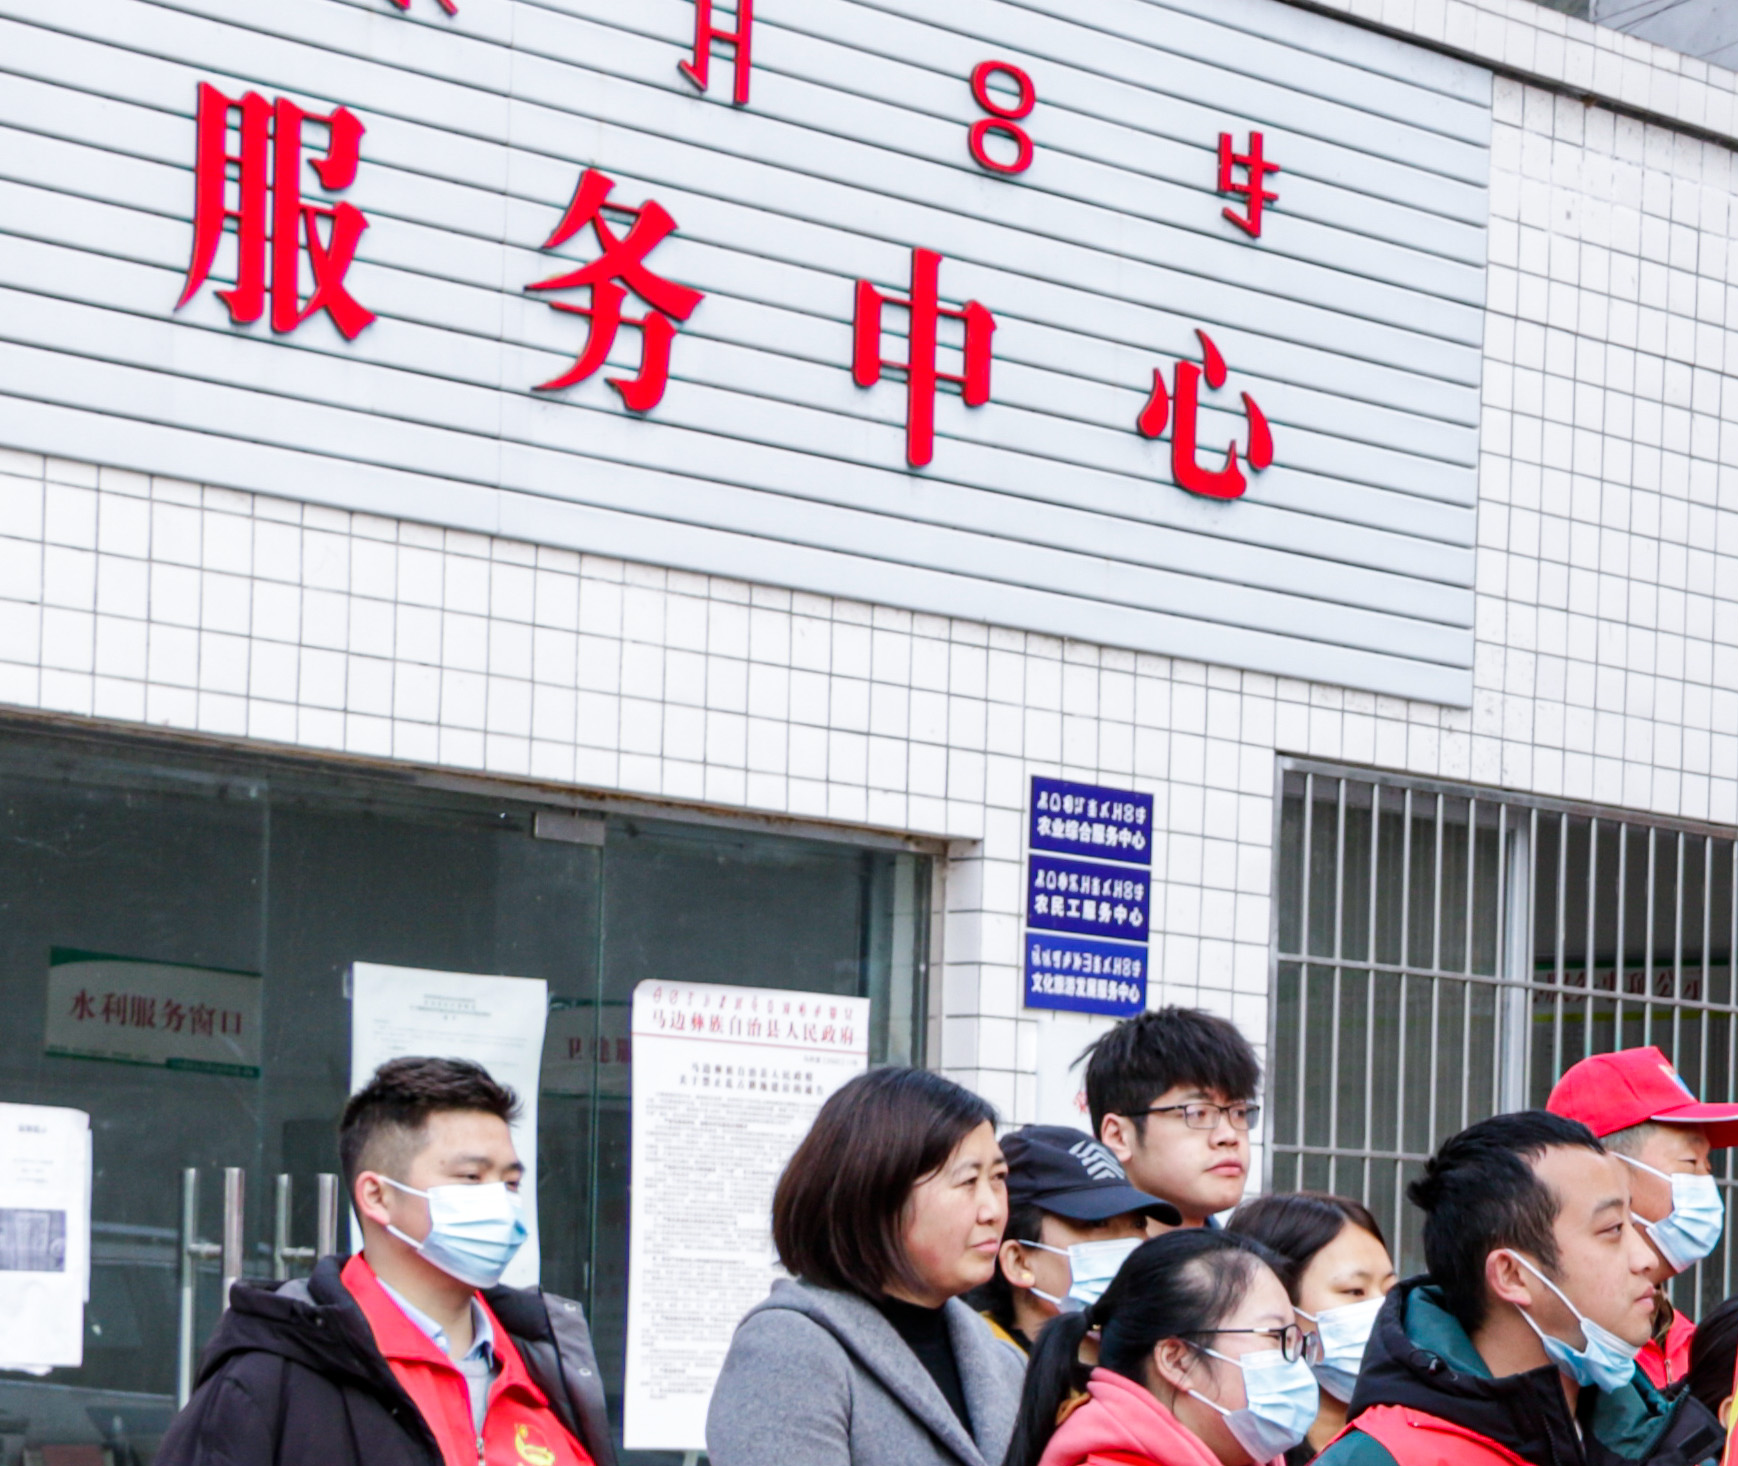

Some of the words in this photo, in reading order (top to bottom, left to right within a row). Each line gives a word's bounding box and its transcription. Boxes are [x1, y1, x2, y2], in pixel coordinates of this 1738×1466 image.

[174, 80, 1276, 502] 服务中心
[1036, 815, 1146, 851] 农业综合服务中心
[1034, 894, 1144, 927] 农民工服务中心
[70, 988, 242, 1037] 水利服务窗口
[652, 1008, 855, 1046] 马边彝族自治县人民政府
